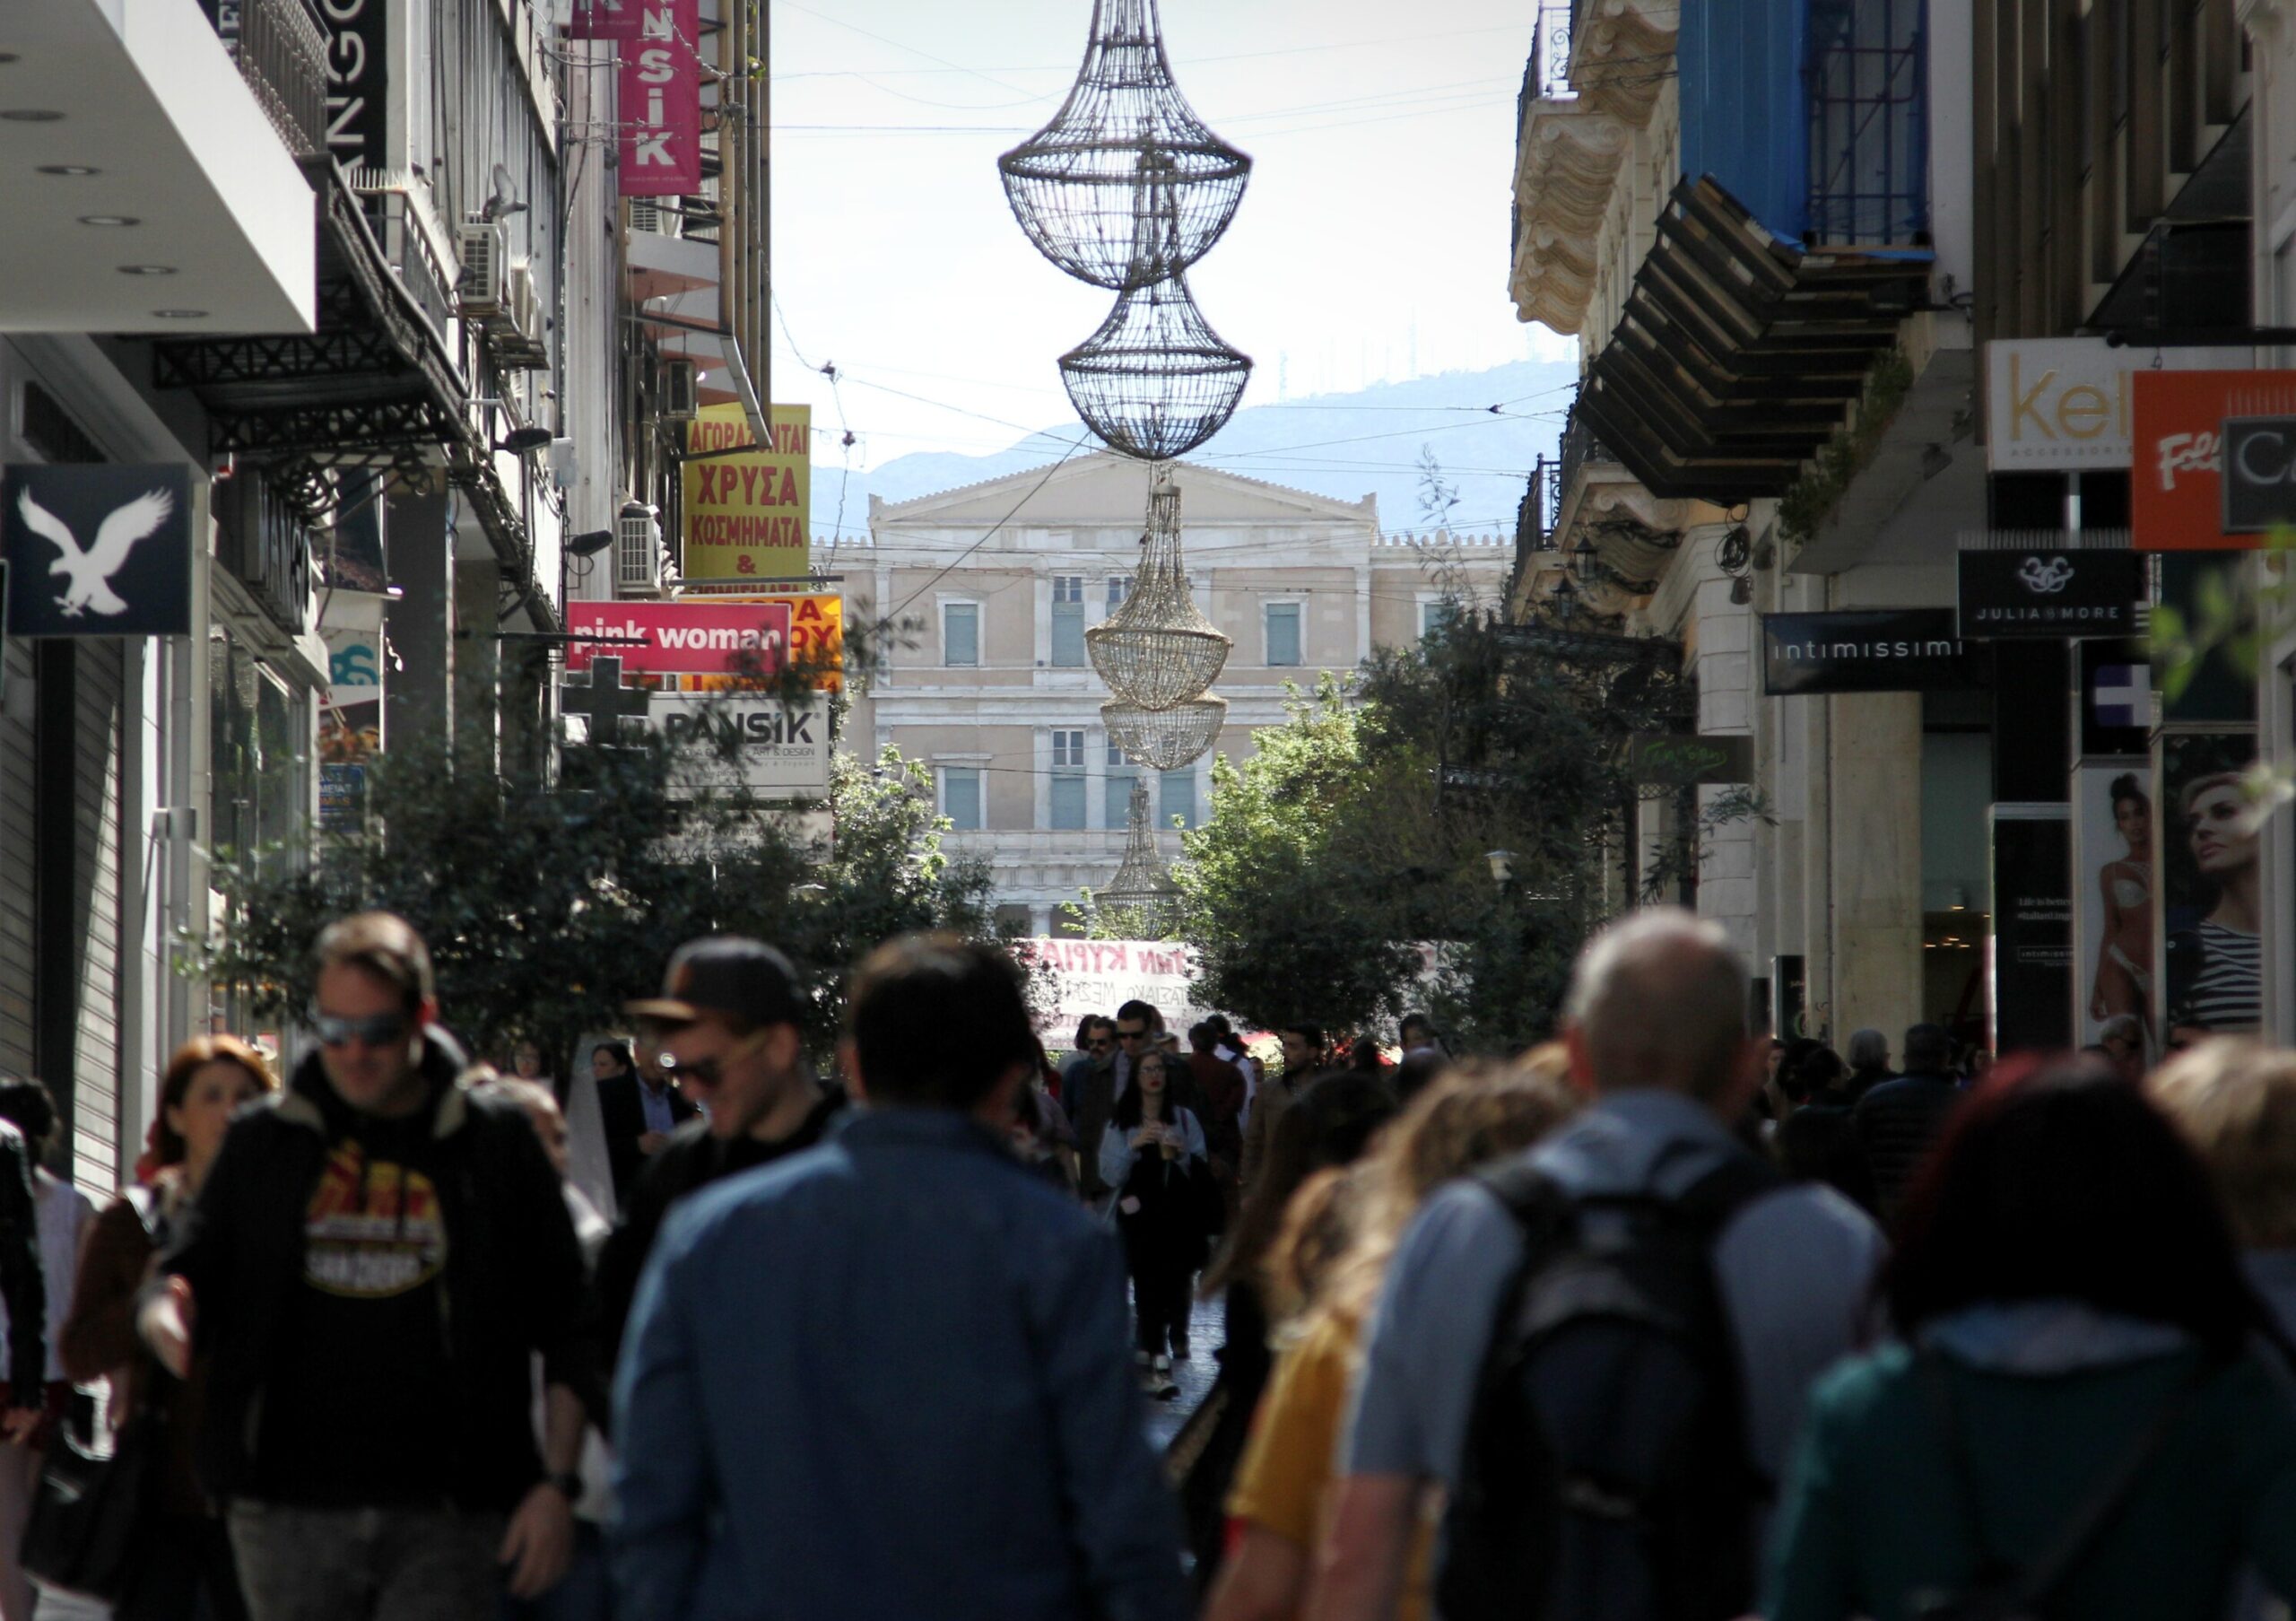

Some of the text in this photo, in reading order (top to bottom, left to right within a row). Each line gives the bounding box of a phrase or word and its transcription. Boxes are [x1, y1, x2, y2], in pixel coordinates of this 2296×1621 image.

[689, 422, 807, 455] ΑΓΟΡΑΝΤΑΙ
[697, 464, 799, 507] ΧΡΥΣΑ
[691, 515, 804, 548] ΚΟΣΜΗΜΑΤΑ
[736, 554, 757, 574] &
[1977, 607, 2040, 620] JULIA
[2062, 607, 2119, 619] MORE
[574, 617, 781, 653] pink woman
[1773, 639, 1963, 660] intimissimi
